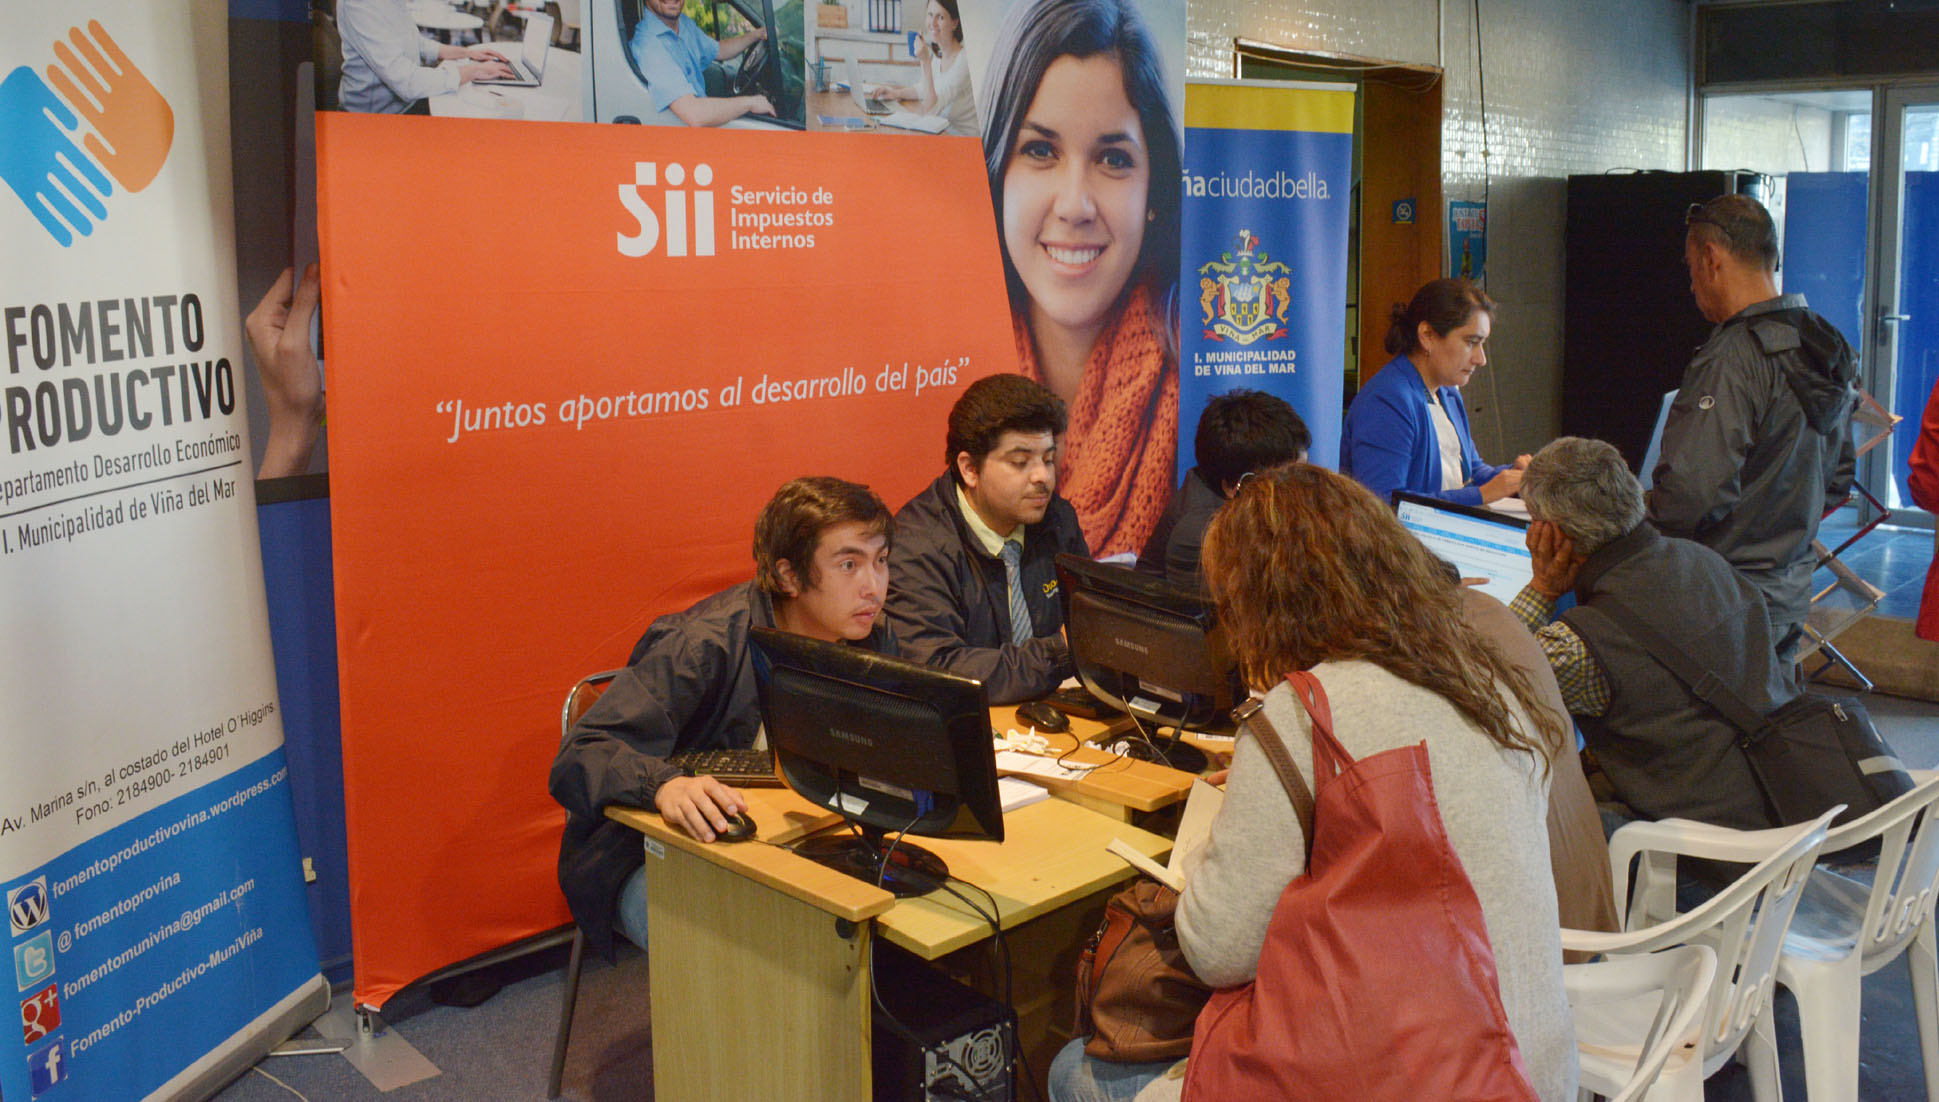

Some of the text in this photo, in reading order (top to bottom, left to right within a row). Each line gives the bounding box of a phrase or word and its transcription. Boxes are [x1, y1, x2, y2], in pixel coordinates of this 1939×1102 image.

[617, 161, 715, 258] Sii
[730, 185, 833, 205] Servicio de
[730, 207, 834, 233] Impuestos
[731, 229, 815, 250] Internos
[4, 292, 205, 375] FOMENTO
[1205, 350, 1297, 364] MUNICIPALIDAD
[559, 388, 709, 431] aportamos
[719, 376, 743, 408] al
[751, 367, 867, 405] desarrollo
[875, 362, 908, 393] del
[1194, 365, 1212, 377] DE
[1244, 363, 1266, 375] DEL
[1269, 362, 1296, 375] MAR
[0, 357, 236, 455] RODUCTIVO
[93, 443, 172, 479] Desarrollo
[175, 430, 241, 462] Económico
[2, 478, 236, 555] I. Municipalidad de Viña del Mar
[1115, 637, 1149, 656] SAMSUNG
[829, 727, 874, 748] SAMSUNG
[1, 816, 26, 836] Av.
[30, 791, 74, 824] Marina
[104, 767, 117, 788] al
[119, 748, 168, 781] costado
[171, 736, 190, 757] del
[193, 722, 224, 748] Hotel
[75, 796, 113, 825] Fono:
[178, 743, 229, 778] 2184901
[63, 877, 256, 1000] fomentomunivina@gmail.com
[74, 870, 182, 940] fomentoprovina
[70, 924, 264, 1059] Fomento-Productivo-MuniViña
